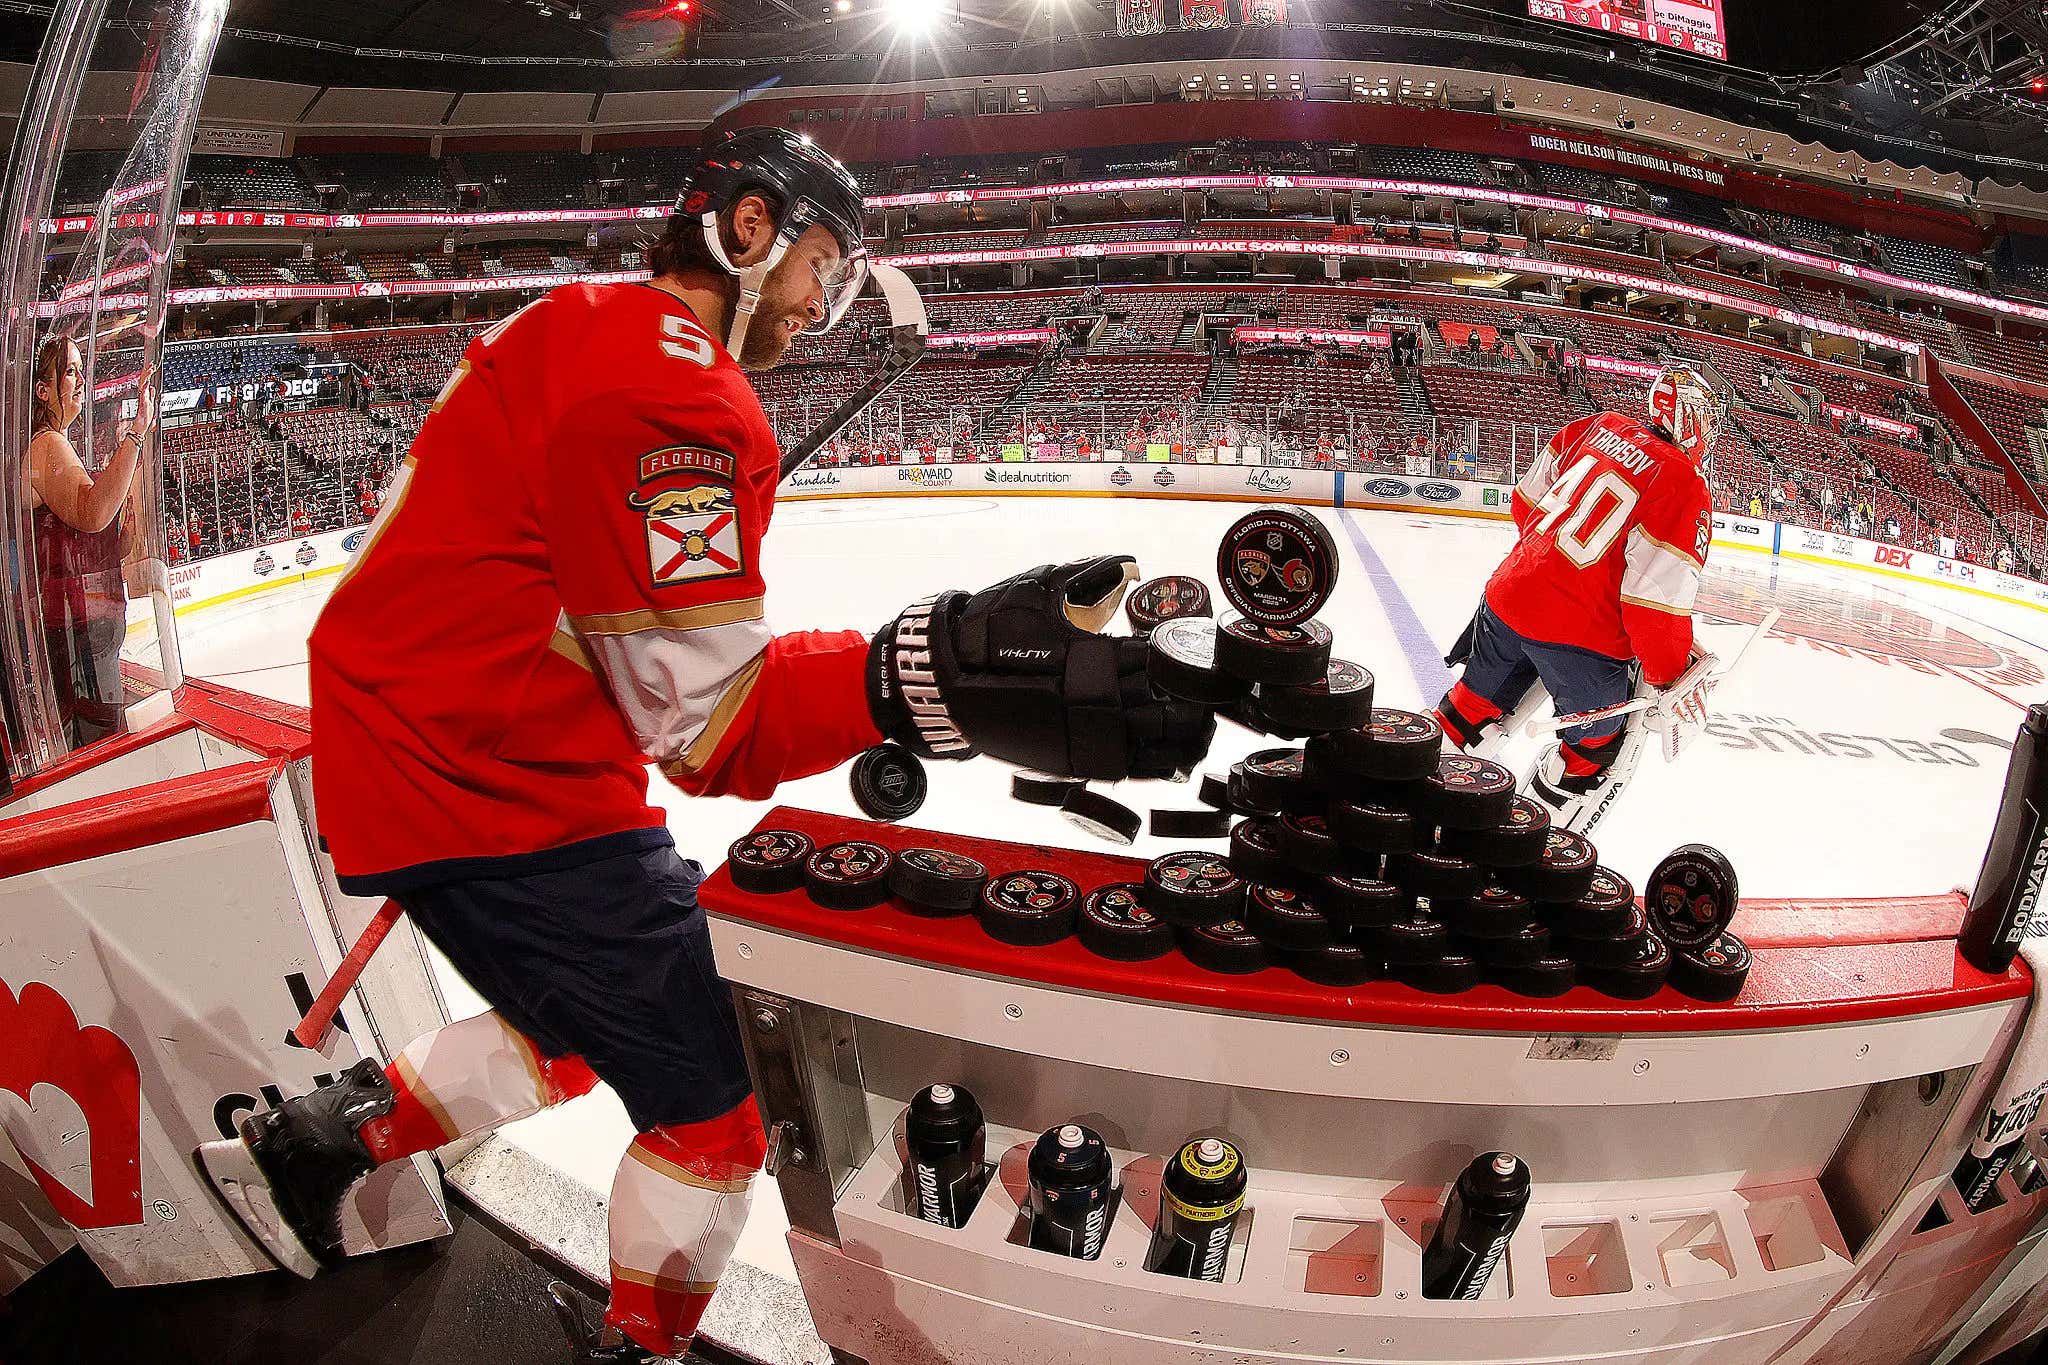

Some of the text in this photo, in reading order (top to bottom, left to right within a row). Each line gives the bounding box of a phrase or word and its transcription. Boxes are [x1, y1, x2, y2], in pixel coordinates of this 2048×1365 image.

[1668, 12, 1712, 30] DiMaggio
[1531, 135, 1725, 186] ROGER NEILSON MEMORIAL PRESS BOX
[1047, 182, 1090, 194] MAKE
[1091, 180, 1136, 191] SOME
[1372, 180, 1418, 192] MAKE
[432, 216, 473, 224] MAKE
[1674, 223, 1710, 238] MAKE
[1193, 242, 1359, 255] MAKE SOME NOISE
[878, 256, 928, 267] SOME
[471, 280, 522, 291] MAKE
[1568, 268, 1708, 301] MAKE SOME NOISE
[172, 288, 275, 301] SOME NOISE
[204, 342, 214, 350] OF
[216, 340, 238, 350] LIGHT
[659, 314, 716, 370] 5
[1588, 426, 1655, 476] TARASOV
[651, 453, 722, 472] FLORIDA
[790, 470, 840, 487] Sandals
[898, 468, 952, 482] BROWARD
[923, 480, 952, 488] COUNTY
[1373, 481, 1402, 496] Ford
[1422, 484, 1451, 499] Ford
[1534, 454, 1640, 570] 40
[1233, 520, 1271, 541] FLORIDA
[1280, 521, 1317, 552] OTTAWA
[1874, 546, 1914, 570] DEX
[1938, 560, 1952, 573] C4
[1960, 565, 1974, 579] C4
[168, 566, 202, 586] ERANT
[172, 588, 192, 602] ANK
[1225, 577, 1319, 621] OFFICIAL WARM-UP PUCK
[1254, 592, 1278, 602] MARCH
[1000, 648, 1050, 660] ALPHA
[896, 602, 972, 754] WARRI
[1704, 722, 1980, 768] CELSIUS
[1058, 1152, 1068, 1163] 5
[1966, 1158, 2007, 1208] ARMOR
[918, 1163, 940, 1225] YARMOR
[1082, 1203, 1105, 1260] ARMOR
